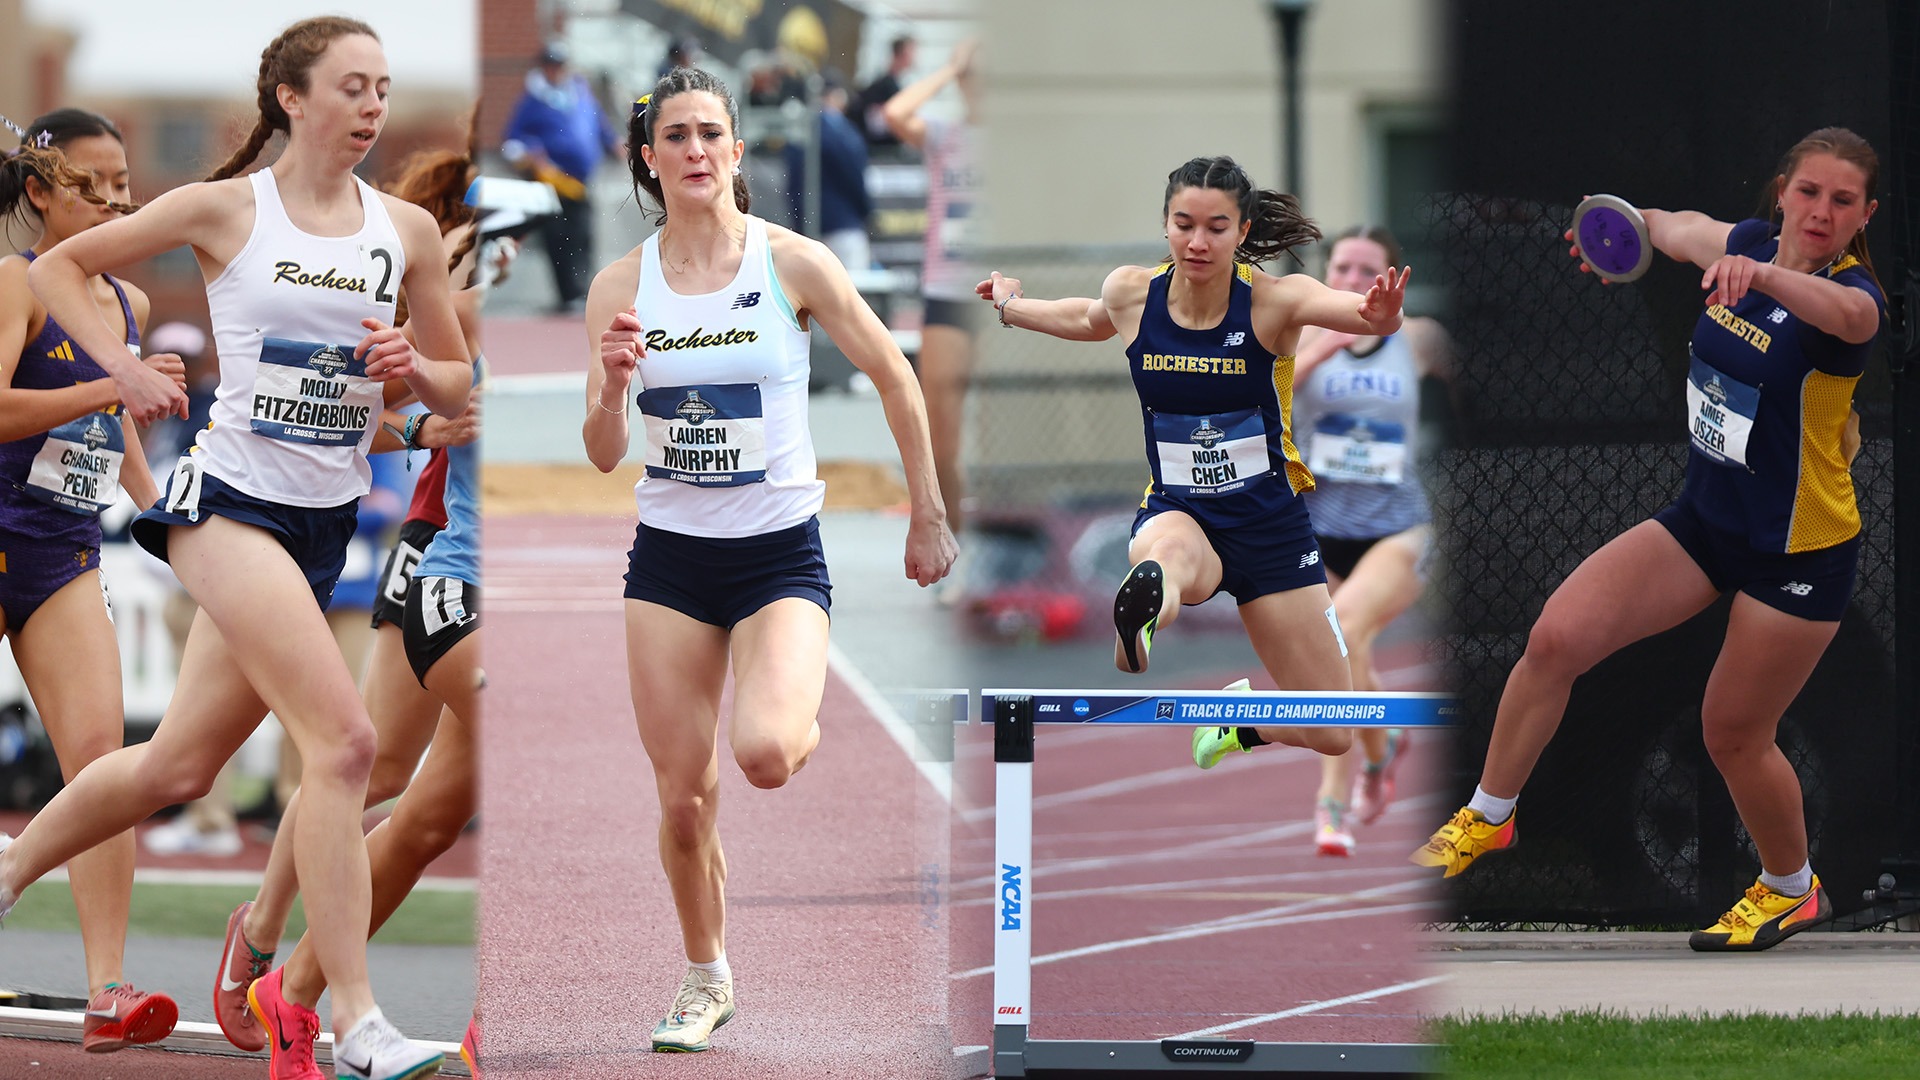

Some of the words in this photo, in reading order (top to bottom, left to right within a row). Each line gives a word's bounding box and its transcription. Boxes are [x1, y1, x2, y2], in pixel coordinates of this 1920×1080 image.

[370, 248, 393, 303] 2
[645, 327, 758, 352] Rochester
[1705, 303, 1772, 354] ROCHESTER
[1142, 354, 1247, 375] ROCHESTER
[300, 377, 348, 400] MOLLY
[253, 394, 370, 429] FITZGIBBONS
[1700, 400, 1726, 428] AIMEE
[284, 427, 291, 435] LA
[292, 428, 318, 439] CROSSE,
[669, 426, 727, 444] LAUREN
[1694, 415, 1726, 453] OSZER
[60, 448, 110, 475] CHARLENE
[663, 446, 741, 471] MURPHY
[1192, 449, 1230, 464] NORA
[62, 471, 98, 500] PENG
[670, 472, 677, 480] LA
[699, 475, 733, 483] WISCONSIN
[1191, 462, 1238, 485] CHEN
[173, 463, 195, 517] 2
[392, 553, 420, 601] 5
[430, 578, 450, 624] 1
[1039, 704, 1061, 712] GILL
[1181, 703, 1224, 718] TRACK
[1224, 704, 1235, 717] &
[1236, 704, 1272, 718] FIELD
[1275, 704, 1386, 719] CHAMPIONSHIPS
[1001, 863, 1022, 931] NCAA
[998, 1006, 1022, 1014] GILL
[1173, 1048, 1240, 1056] CONTINUUM
